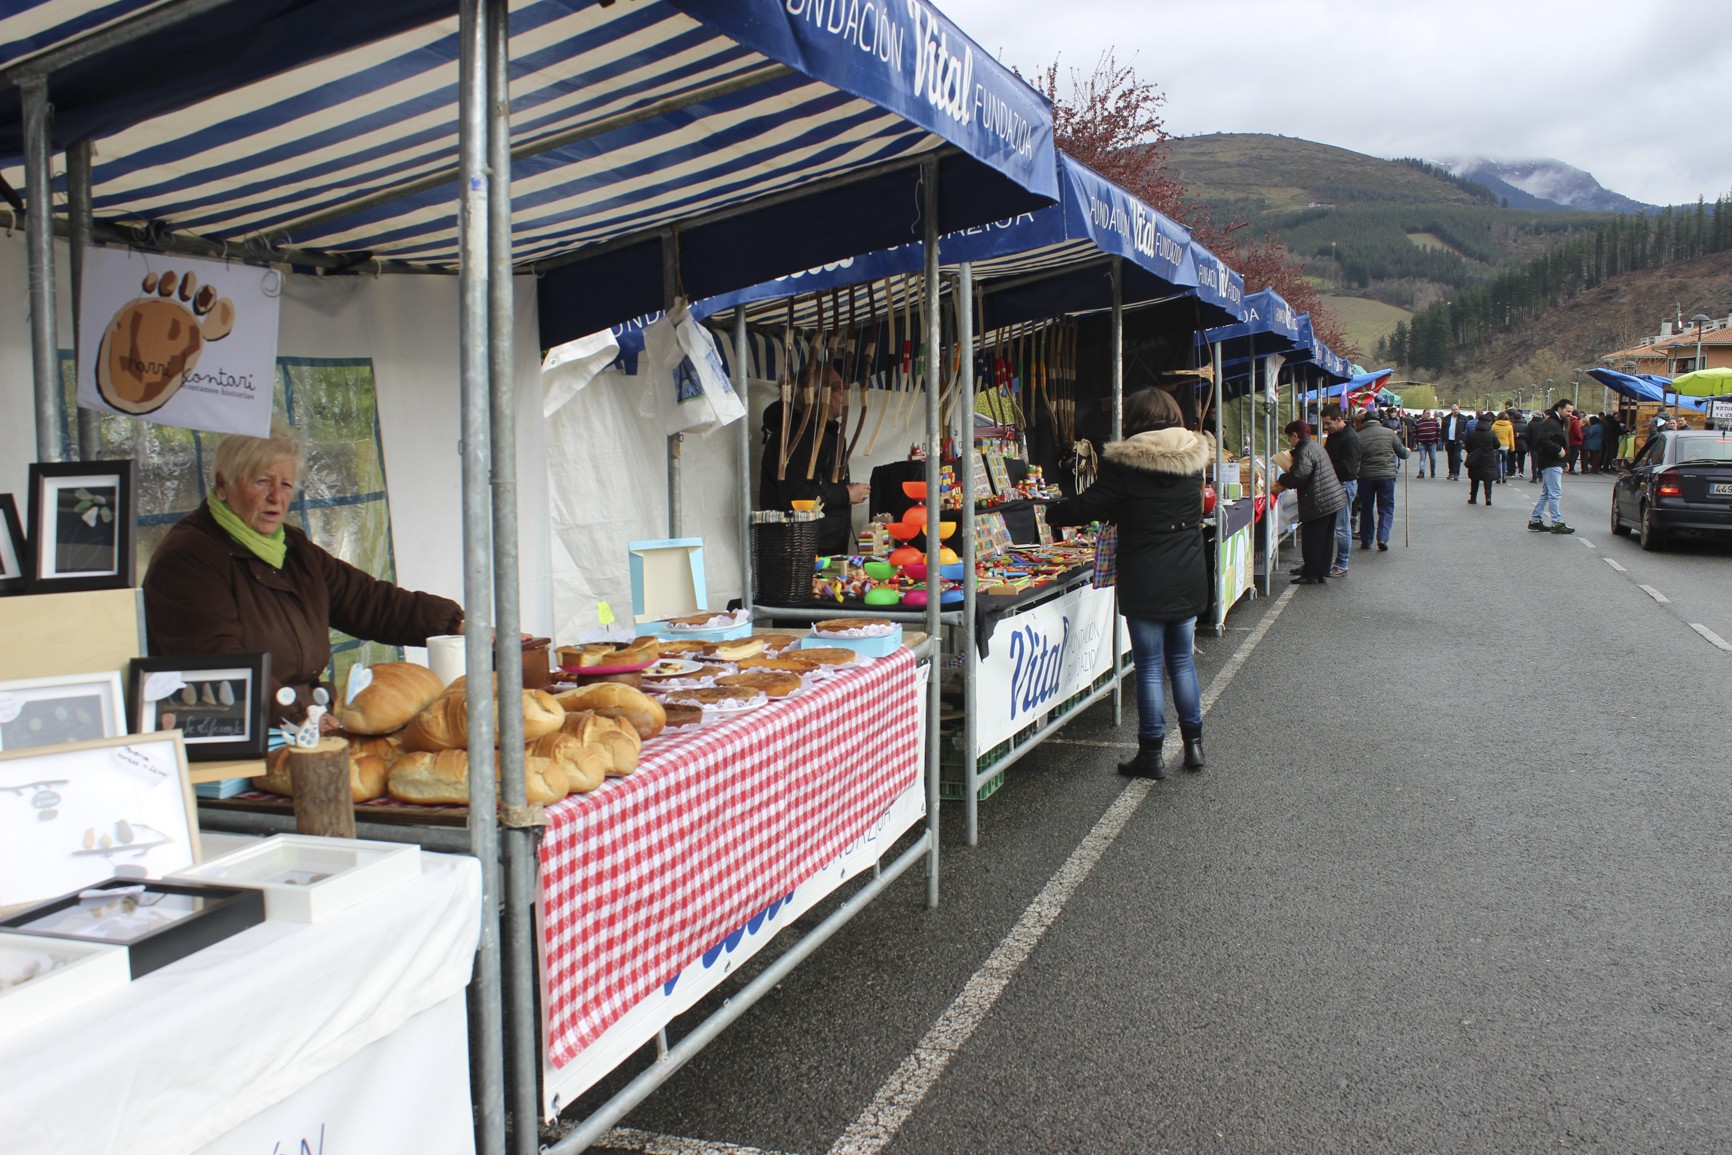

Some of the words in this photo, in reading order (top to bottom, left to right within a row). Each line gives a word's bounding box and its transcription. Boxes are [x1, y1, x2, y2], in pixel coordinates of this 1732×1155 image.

[786, 0, 904, 72] NDACIÓN
[906, 0, 973, 126] Vital
[973, 83, 1033, 160] FUNDAZIOA
[1129, 196, 1157, 259] Vital
[181, 367, 256, 391] kontari
[220, 386, 255, 400] historias
[1010, 616, 1069, 720] Vital
